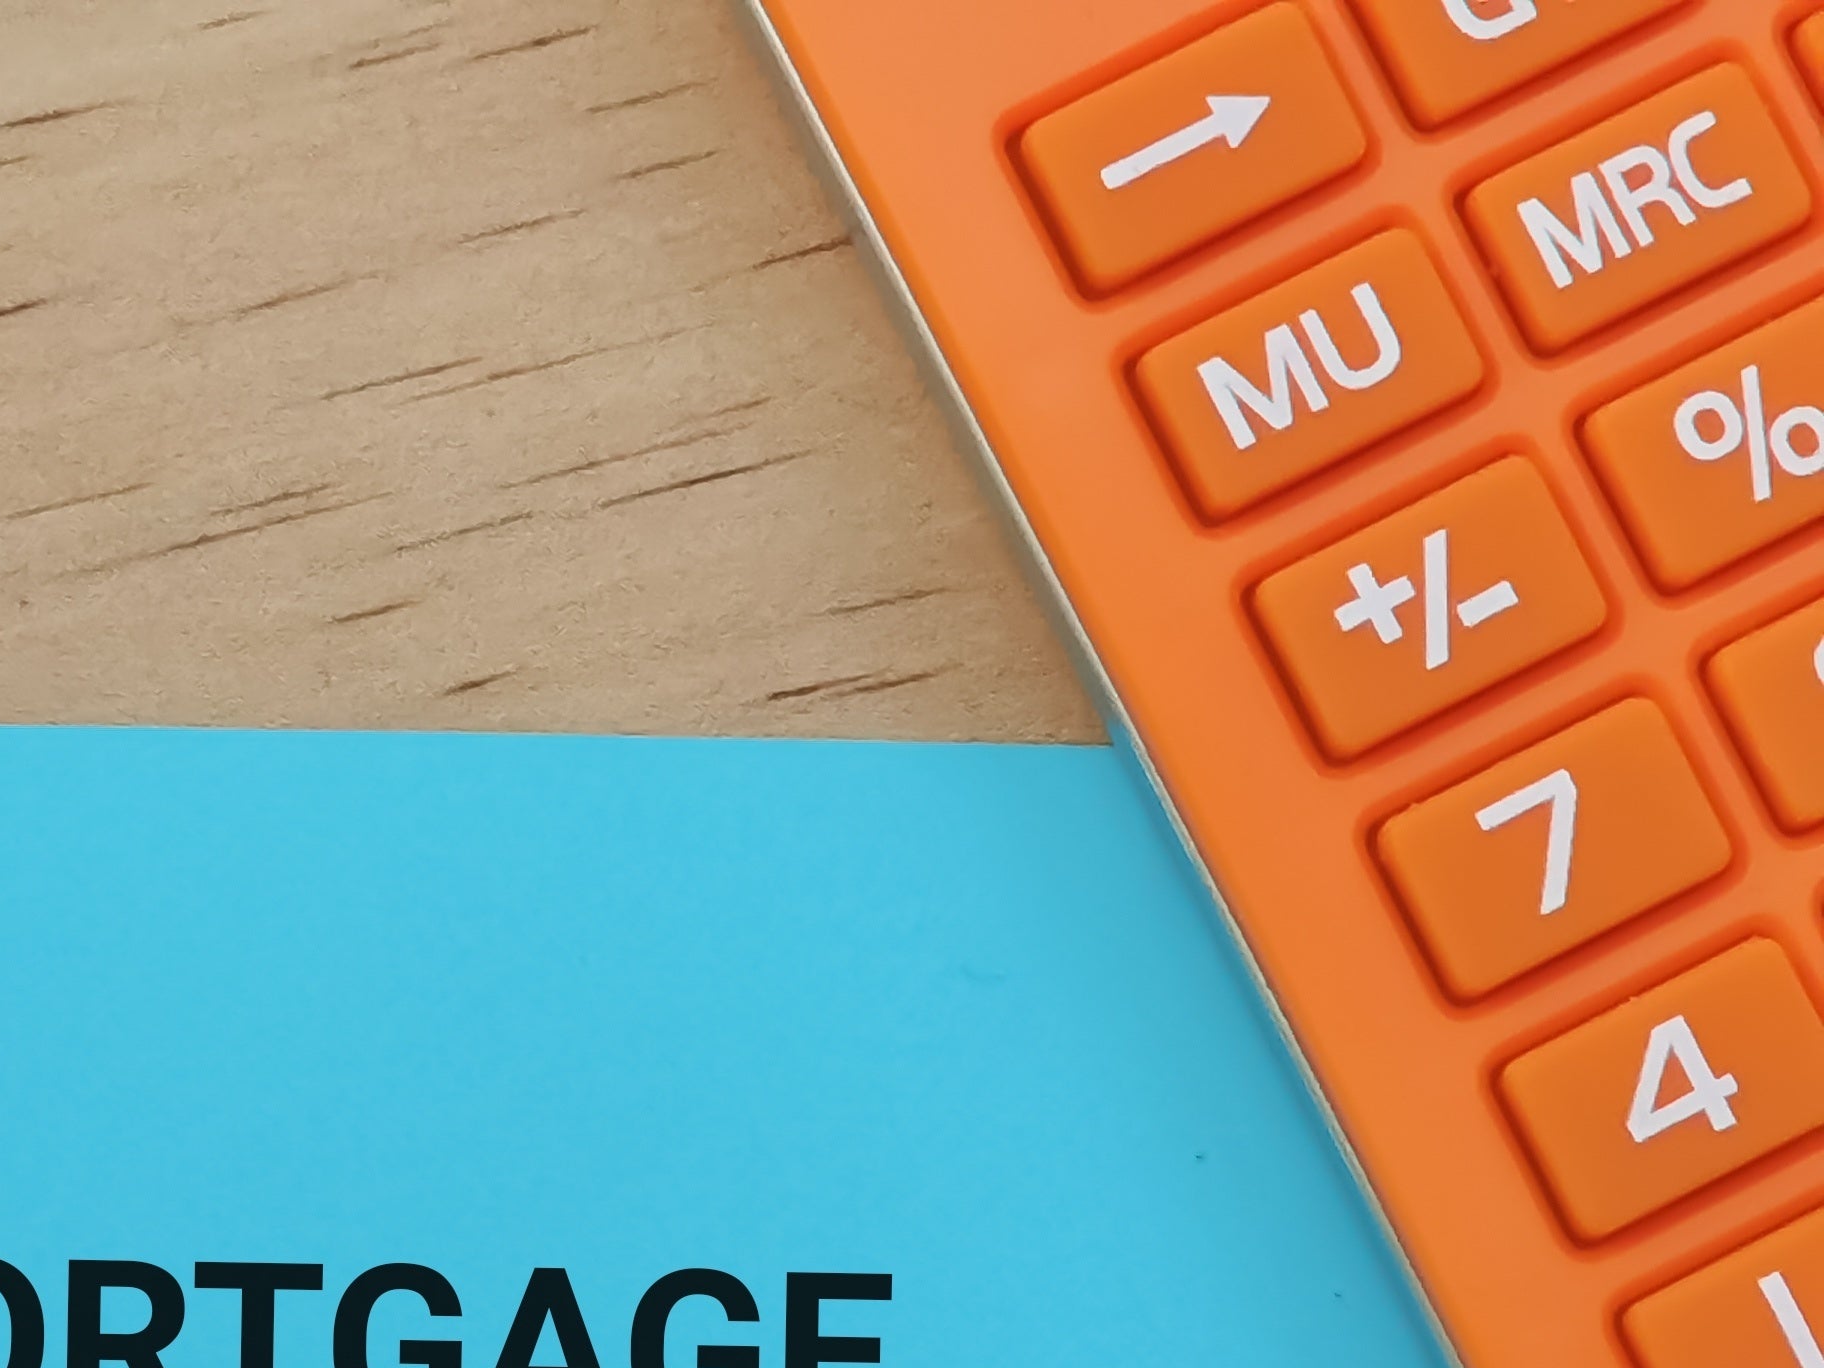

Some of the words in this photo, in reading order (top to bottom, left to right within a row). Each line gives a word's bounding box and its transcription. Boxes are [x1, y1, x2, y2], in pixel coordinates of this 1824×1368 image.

[1517, 110, 1753, 289] MRC
[1196, 282, 1401, 450] MU
[1475, 768, 1578, 915] 7
[1626, 1014, 1739, 1143] 4
